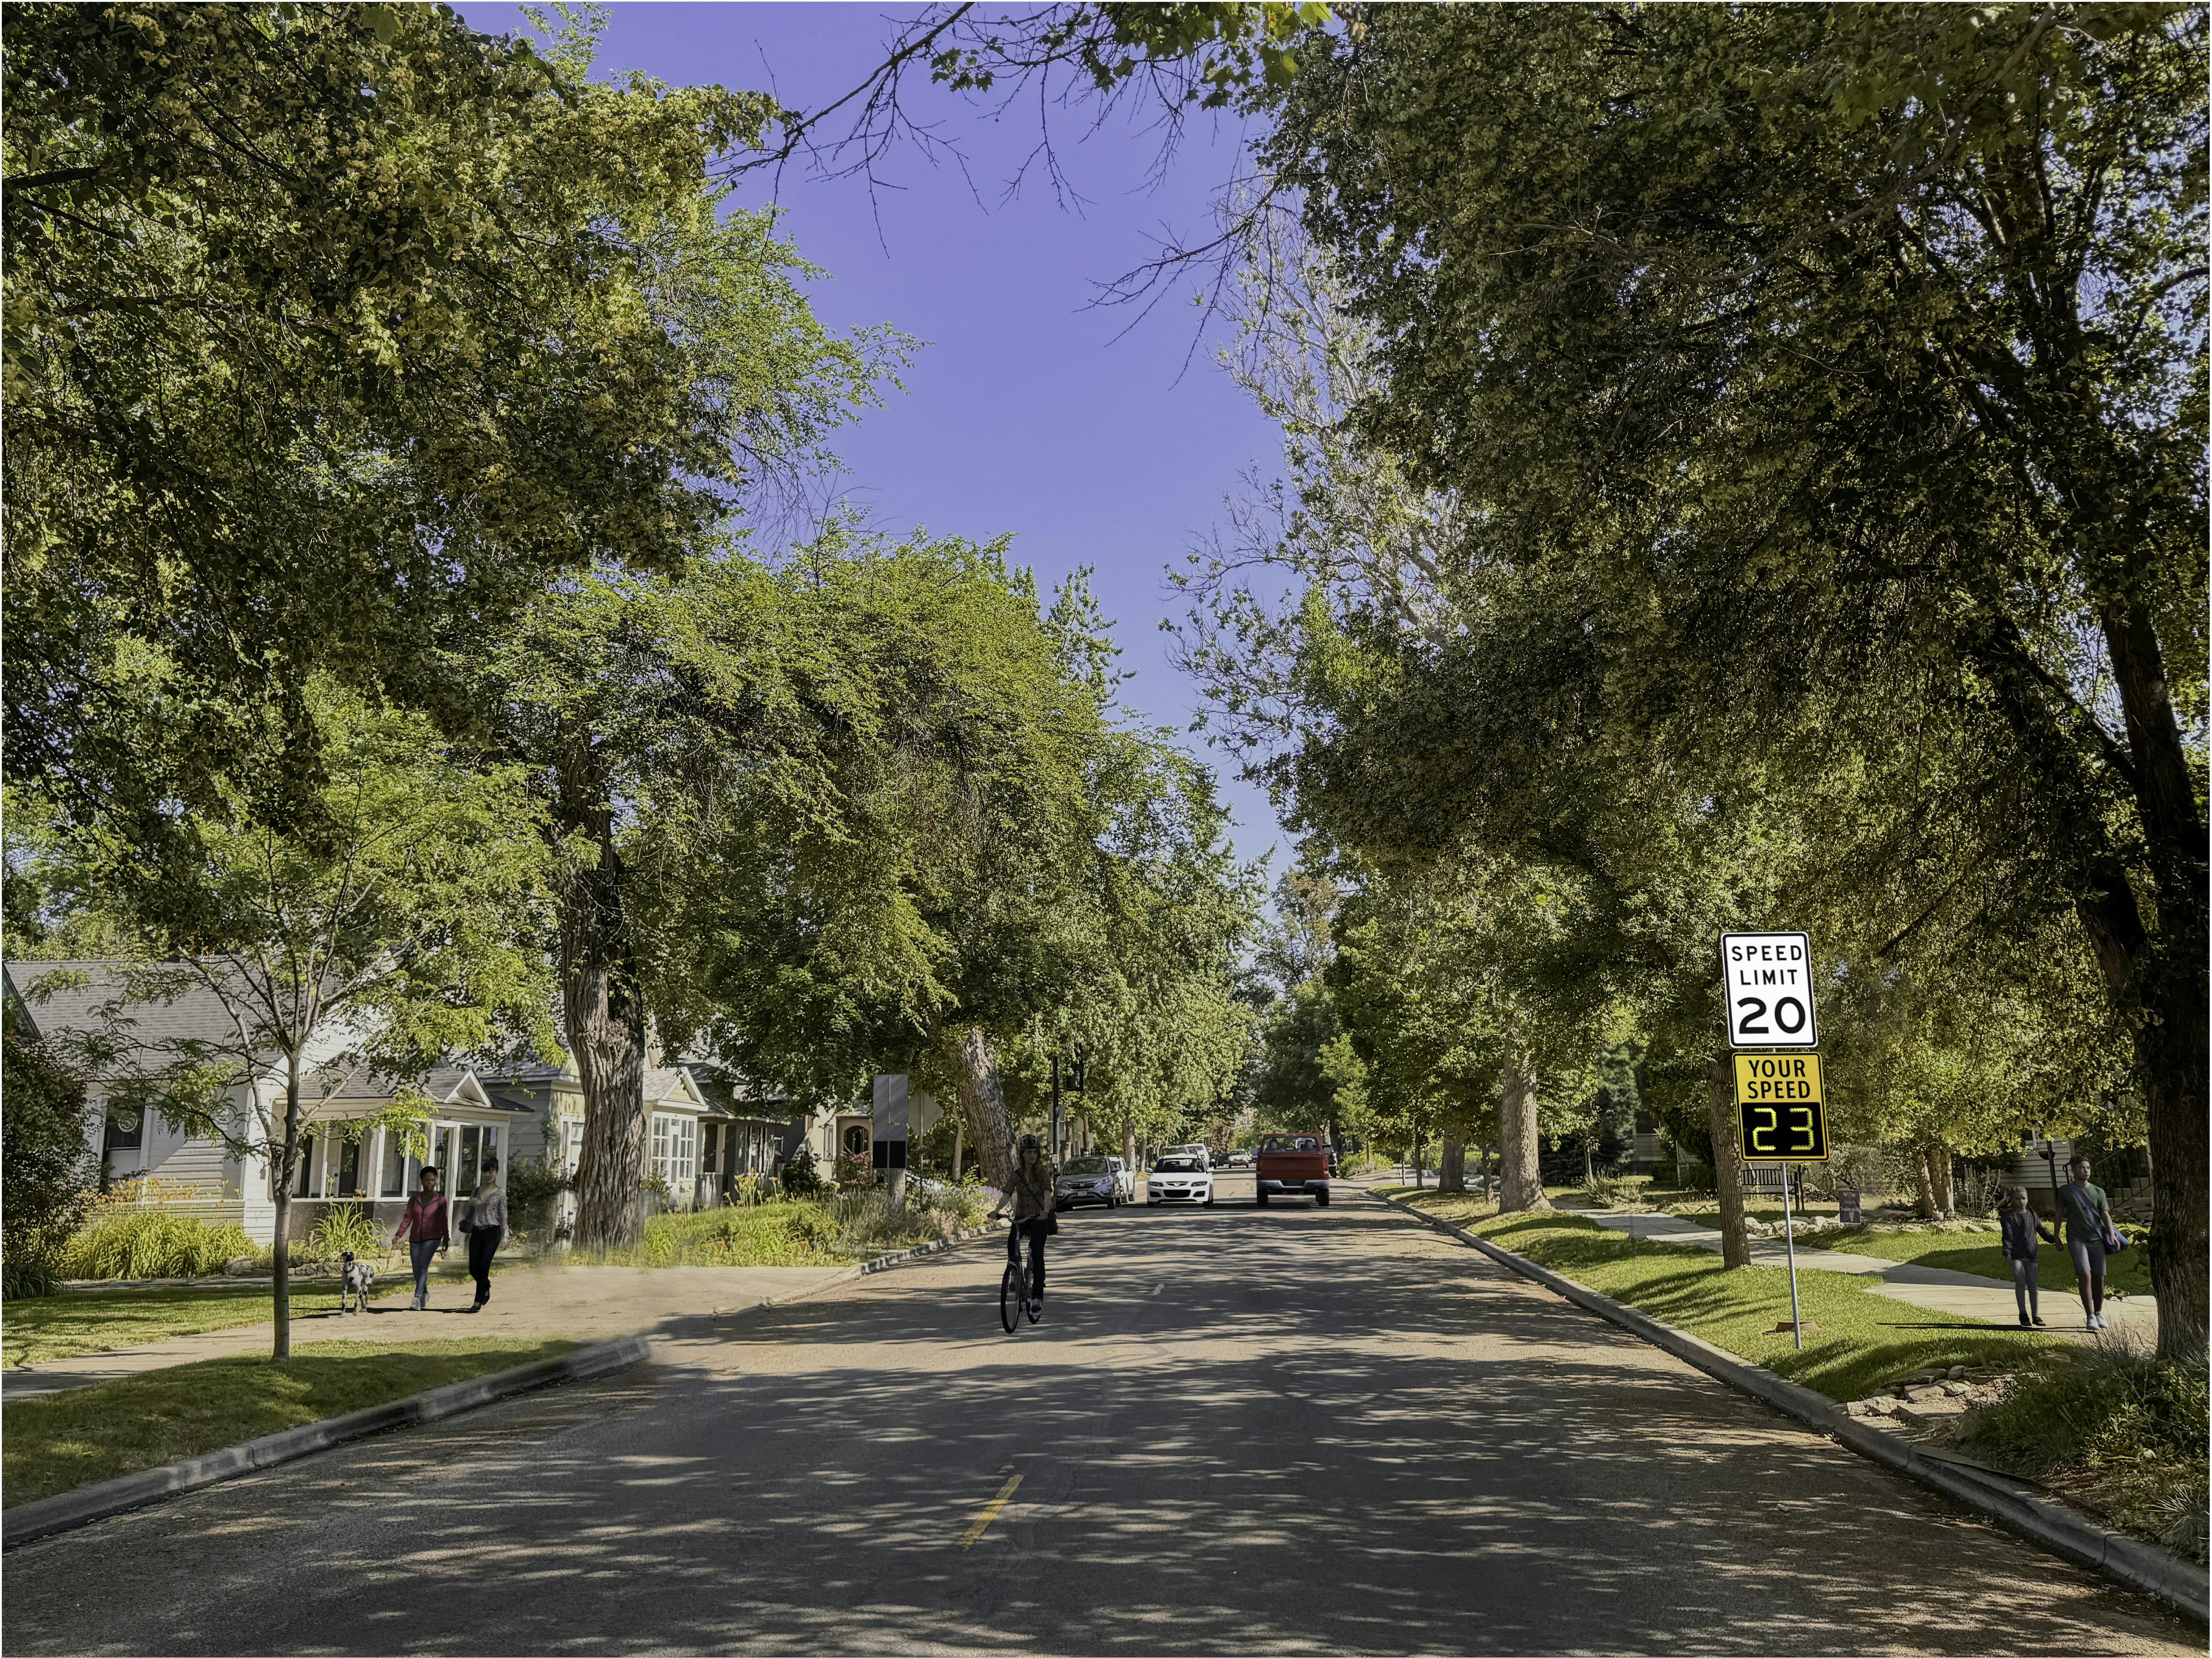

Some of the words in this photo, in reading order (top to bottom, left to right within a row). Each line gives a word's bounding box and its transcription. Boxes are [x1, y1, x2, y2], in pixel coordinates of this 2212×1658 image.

[1732, 945, 1802, 961] SPEED
[1740, 970, 1797, 985] LIMIT
[1737, 997, 1805, 1034] 20
[1748, 1060, 1805, 1077] YOUR
[1748, 1081, 1810, 1099] SPEED
[1753, 1108, 1814, 1150] 23
